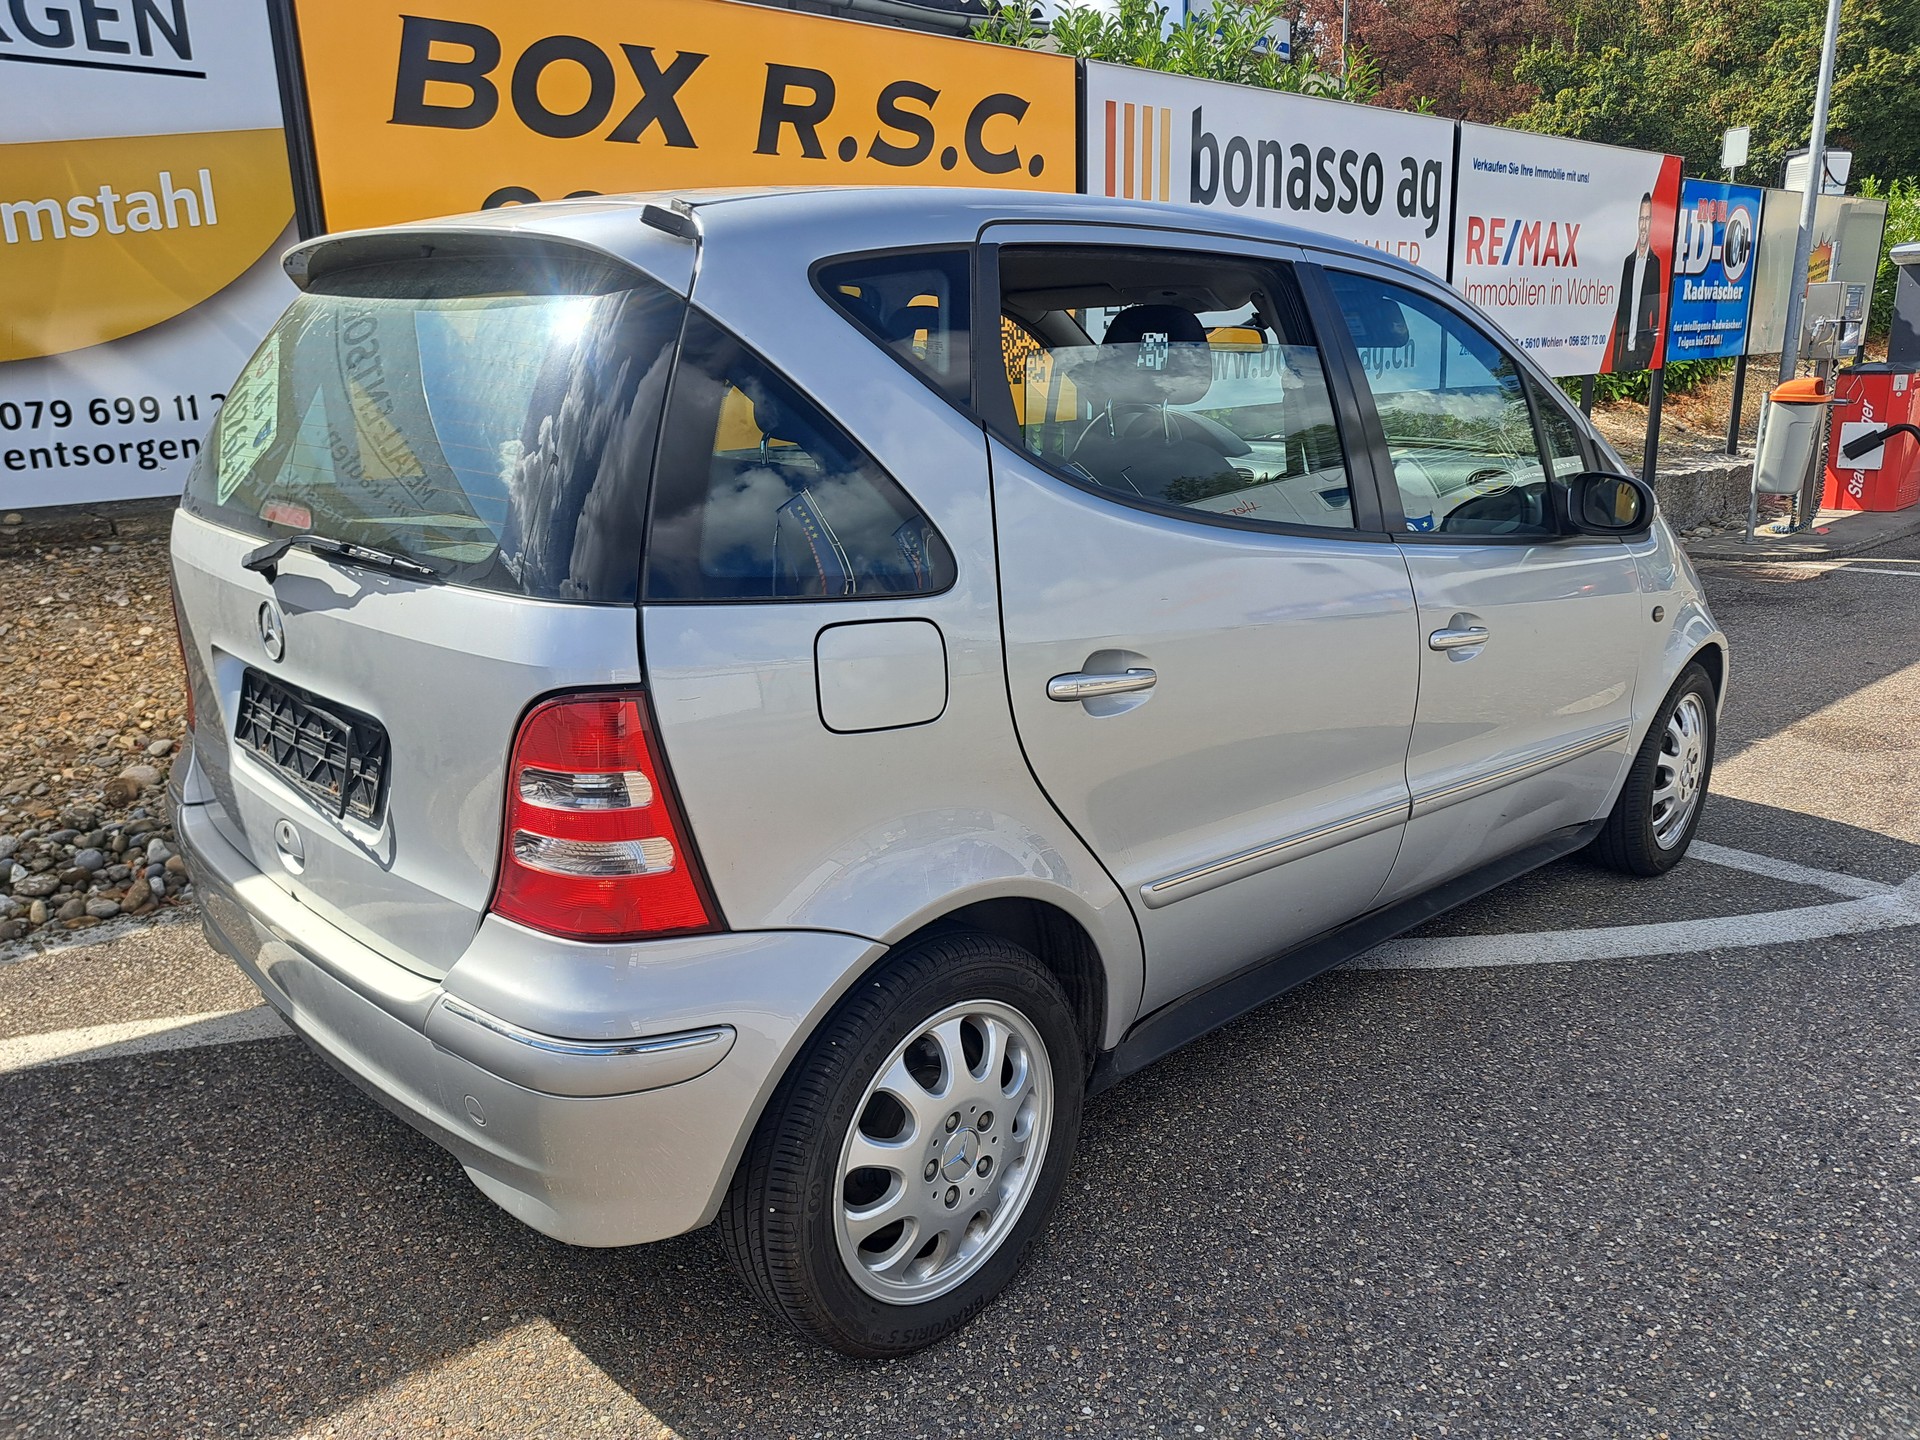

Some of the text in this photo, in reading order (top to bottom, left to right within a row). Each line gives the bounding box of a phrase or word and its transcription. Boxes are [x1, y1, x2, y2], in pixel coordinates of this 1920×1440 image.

[0, 0, 193, 61] GEN
[386, 14, 1045, 177] BOX R.S.C.
[1190, 105, 1442, 238] bonasso ag
[1473, 157, 1590, 183] Verkaufen Sie Ihre Immobilie mit uns!
[0, 168, 218, 243] mstahl
[1697, 199, 1728, 222] neu
[1465, 215, 1581, 267] RE/MAX
[1464, 276, 1614, 306] Immobilien in Wohlen
[1683, 279, 1743, 301] Radwäscher
[1525, 337, 1540, 349] 5610
[1541, 336, 1563, 348] Wohlen
[1569, 335, 1579, 346] 056
[1580, 335, 1590, 346] 521
[1592, 334, 1598, 345] 72
[1599, 334, 1607, 345] 00
[1673, 321, 1682, 332] der
[1682, 320, 1711, 333] intelligente
[1695, 335, 1703, 345] bis
[0, 400, 73, 431] 079
[88, 396, 161, 426] 699
[173, 395, 200, 421] 11
[4, 438, 200, 470] entsorgen
[902, 1295, 985, 1344] BRAVURIS
